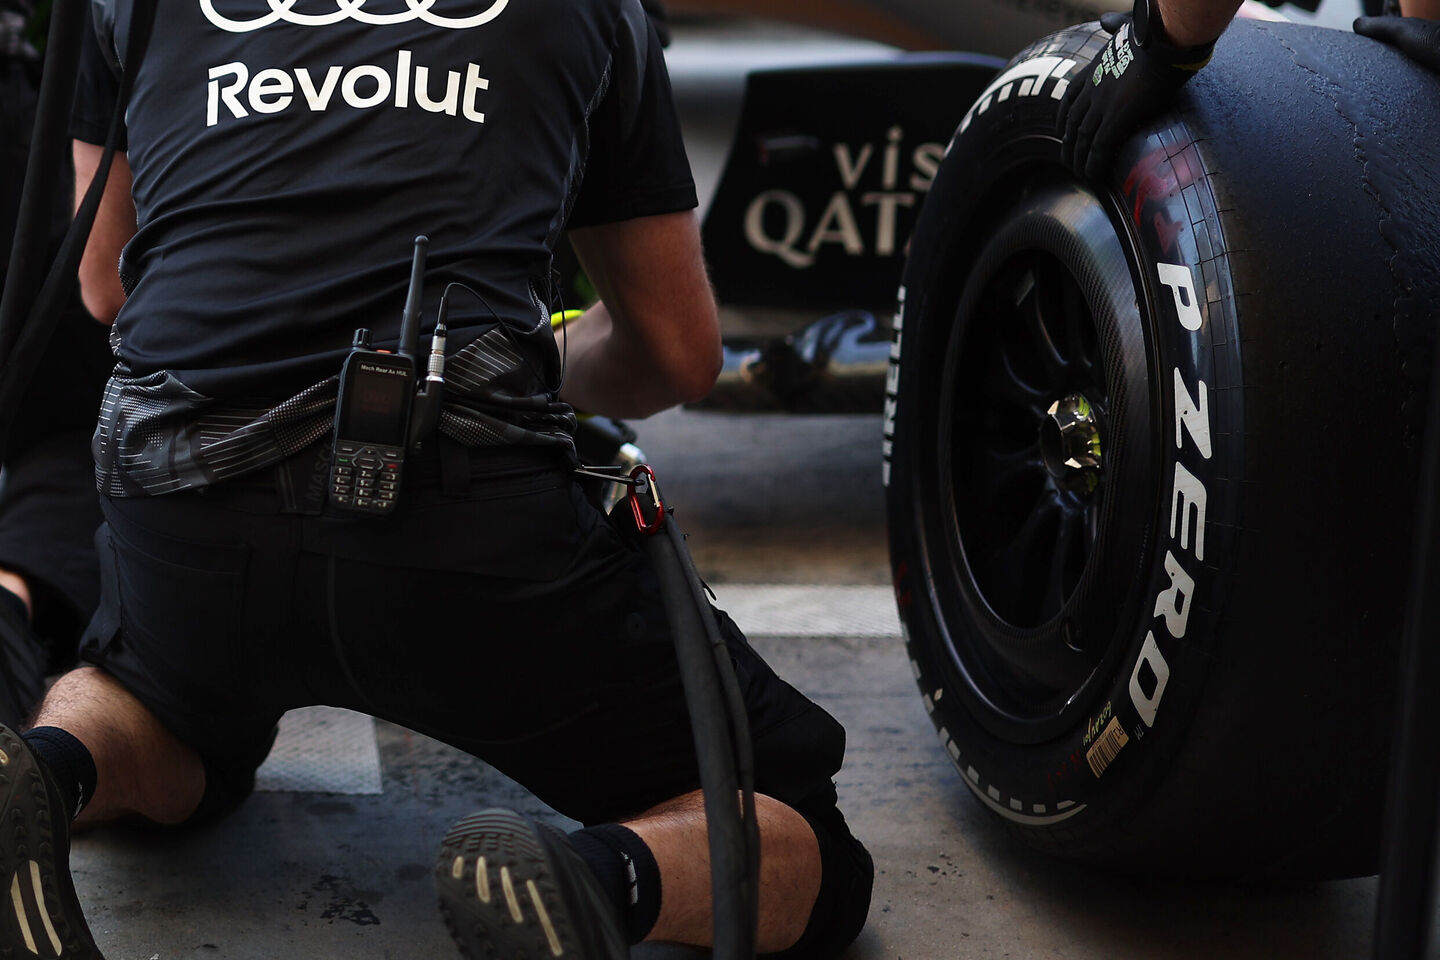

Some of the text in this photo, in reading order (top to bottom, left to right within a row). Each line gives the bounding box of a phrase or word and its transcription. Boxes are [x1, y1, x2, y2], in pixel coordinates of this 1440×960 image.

[206, 49, 490, 127] Revolut
[833, 125, 946, 191] vis
[744, 190, 915, 269] QAT
[361, 364, 375, 372] Mech
[882, 284, 906, 488] IRELLI
[1129, 367, 1213, 728] ZERO
